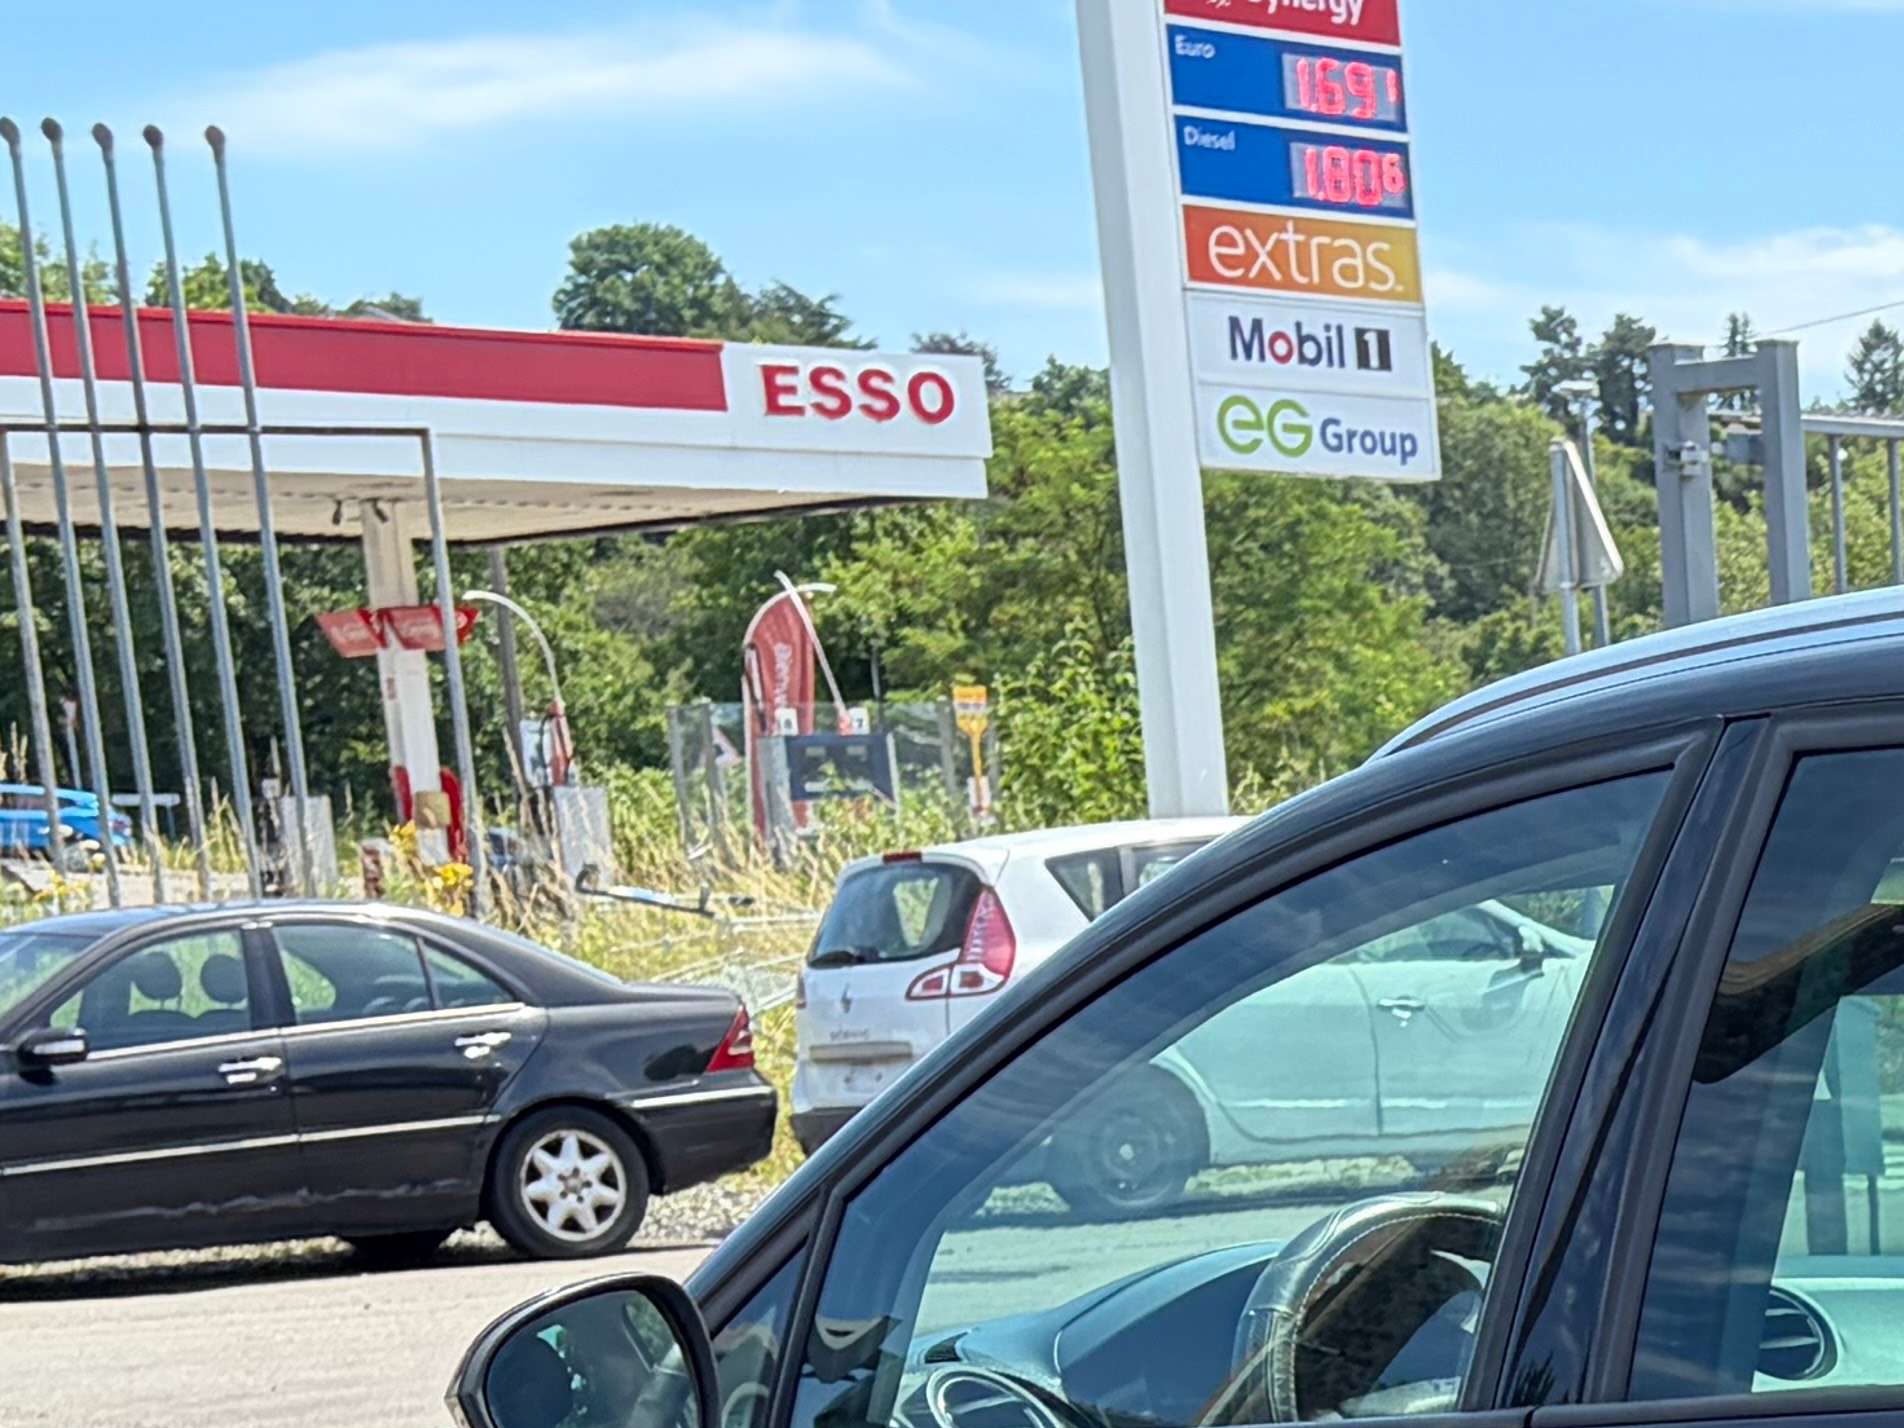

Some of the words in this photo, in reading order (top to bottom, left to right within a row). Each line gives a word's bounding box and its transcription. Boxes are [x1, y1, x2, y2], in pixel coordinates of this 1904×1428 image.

[1248, 0, 1363, 26] yergy
[1174, 35, 1216, 59] Euro
[1183, 126, 1236, 151] Diesel
[1228, 315, 1346, 369] Mobil
[758, 363, 956, 425] ESSO
[1319, 416, 1419, 466] Group
